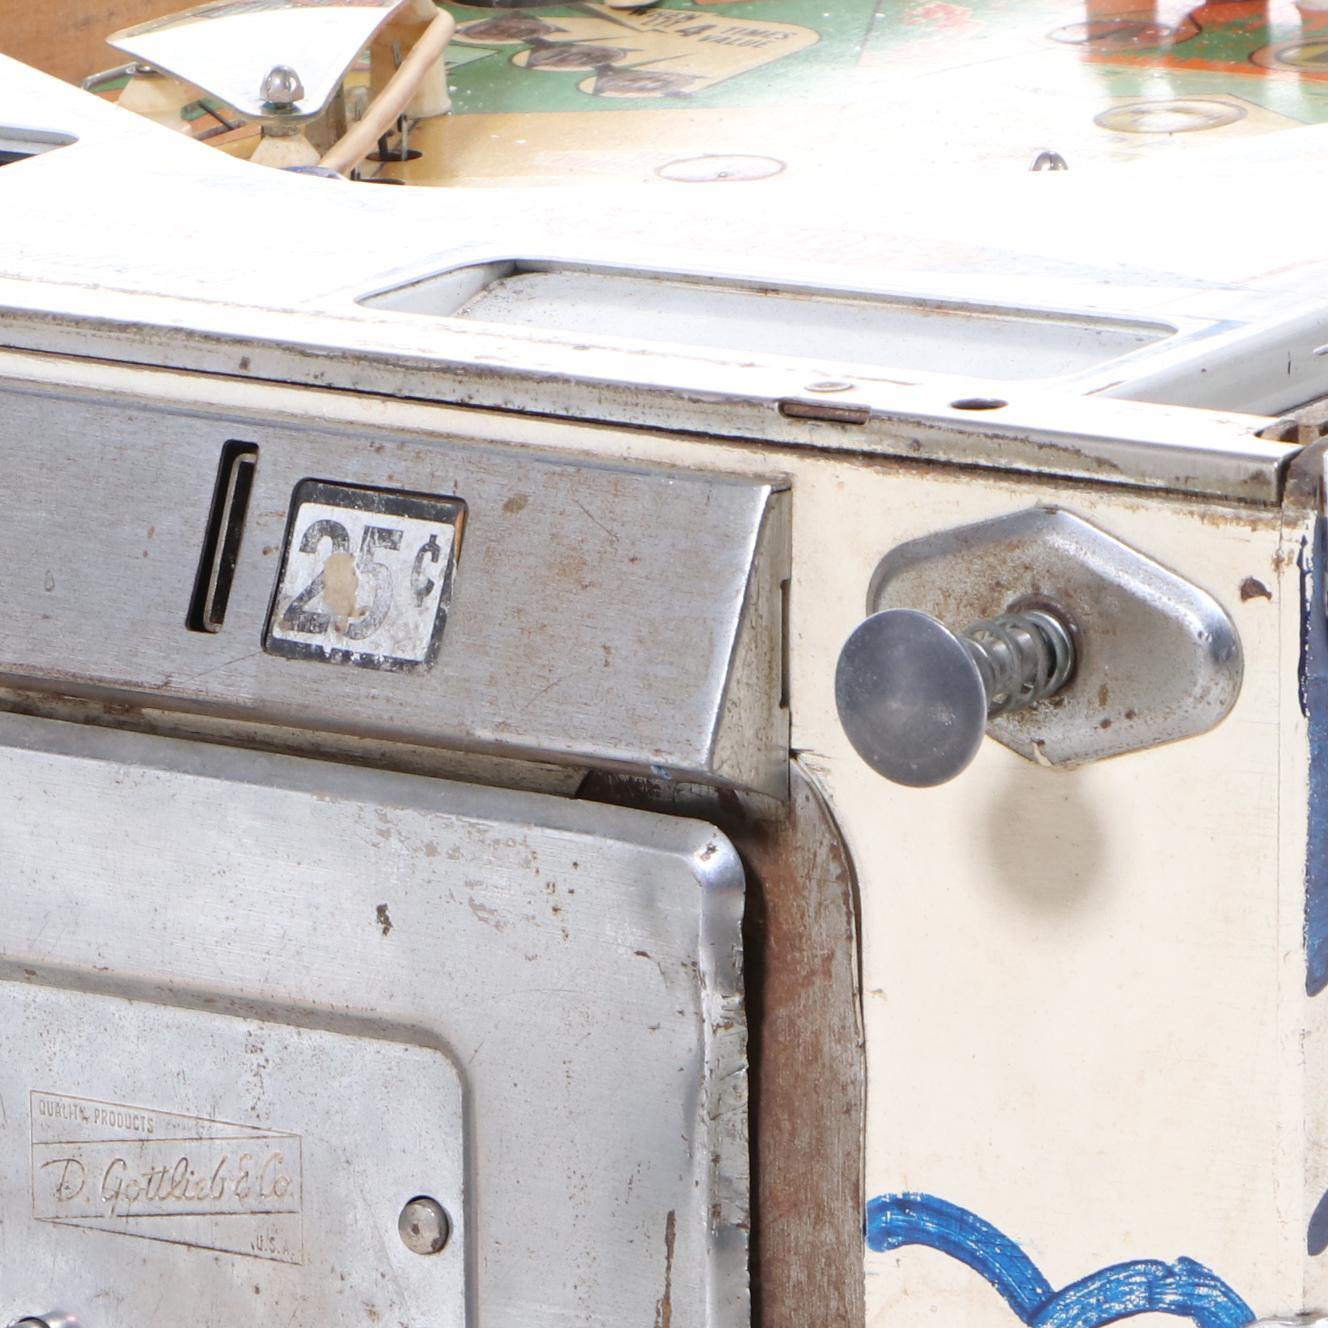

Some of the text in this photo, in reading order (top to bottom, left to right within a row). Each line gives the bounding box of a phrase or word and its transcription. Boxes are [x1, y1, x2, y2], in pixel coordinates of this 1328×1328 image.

[674, 25, 717, 37] 4
[39, 1099, 154, 1134] QUALITY PRODUCTS
[102, 1156, 228, 1218] Gottlieb
